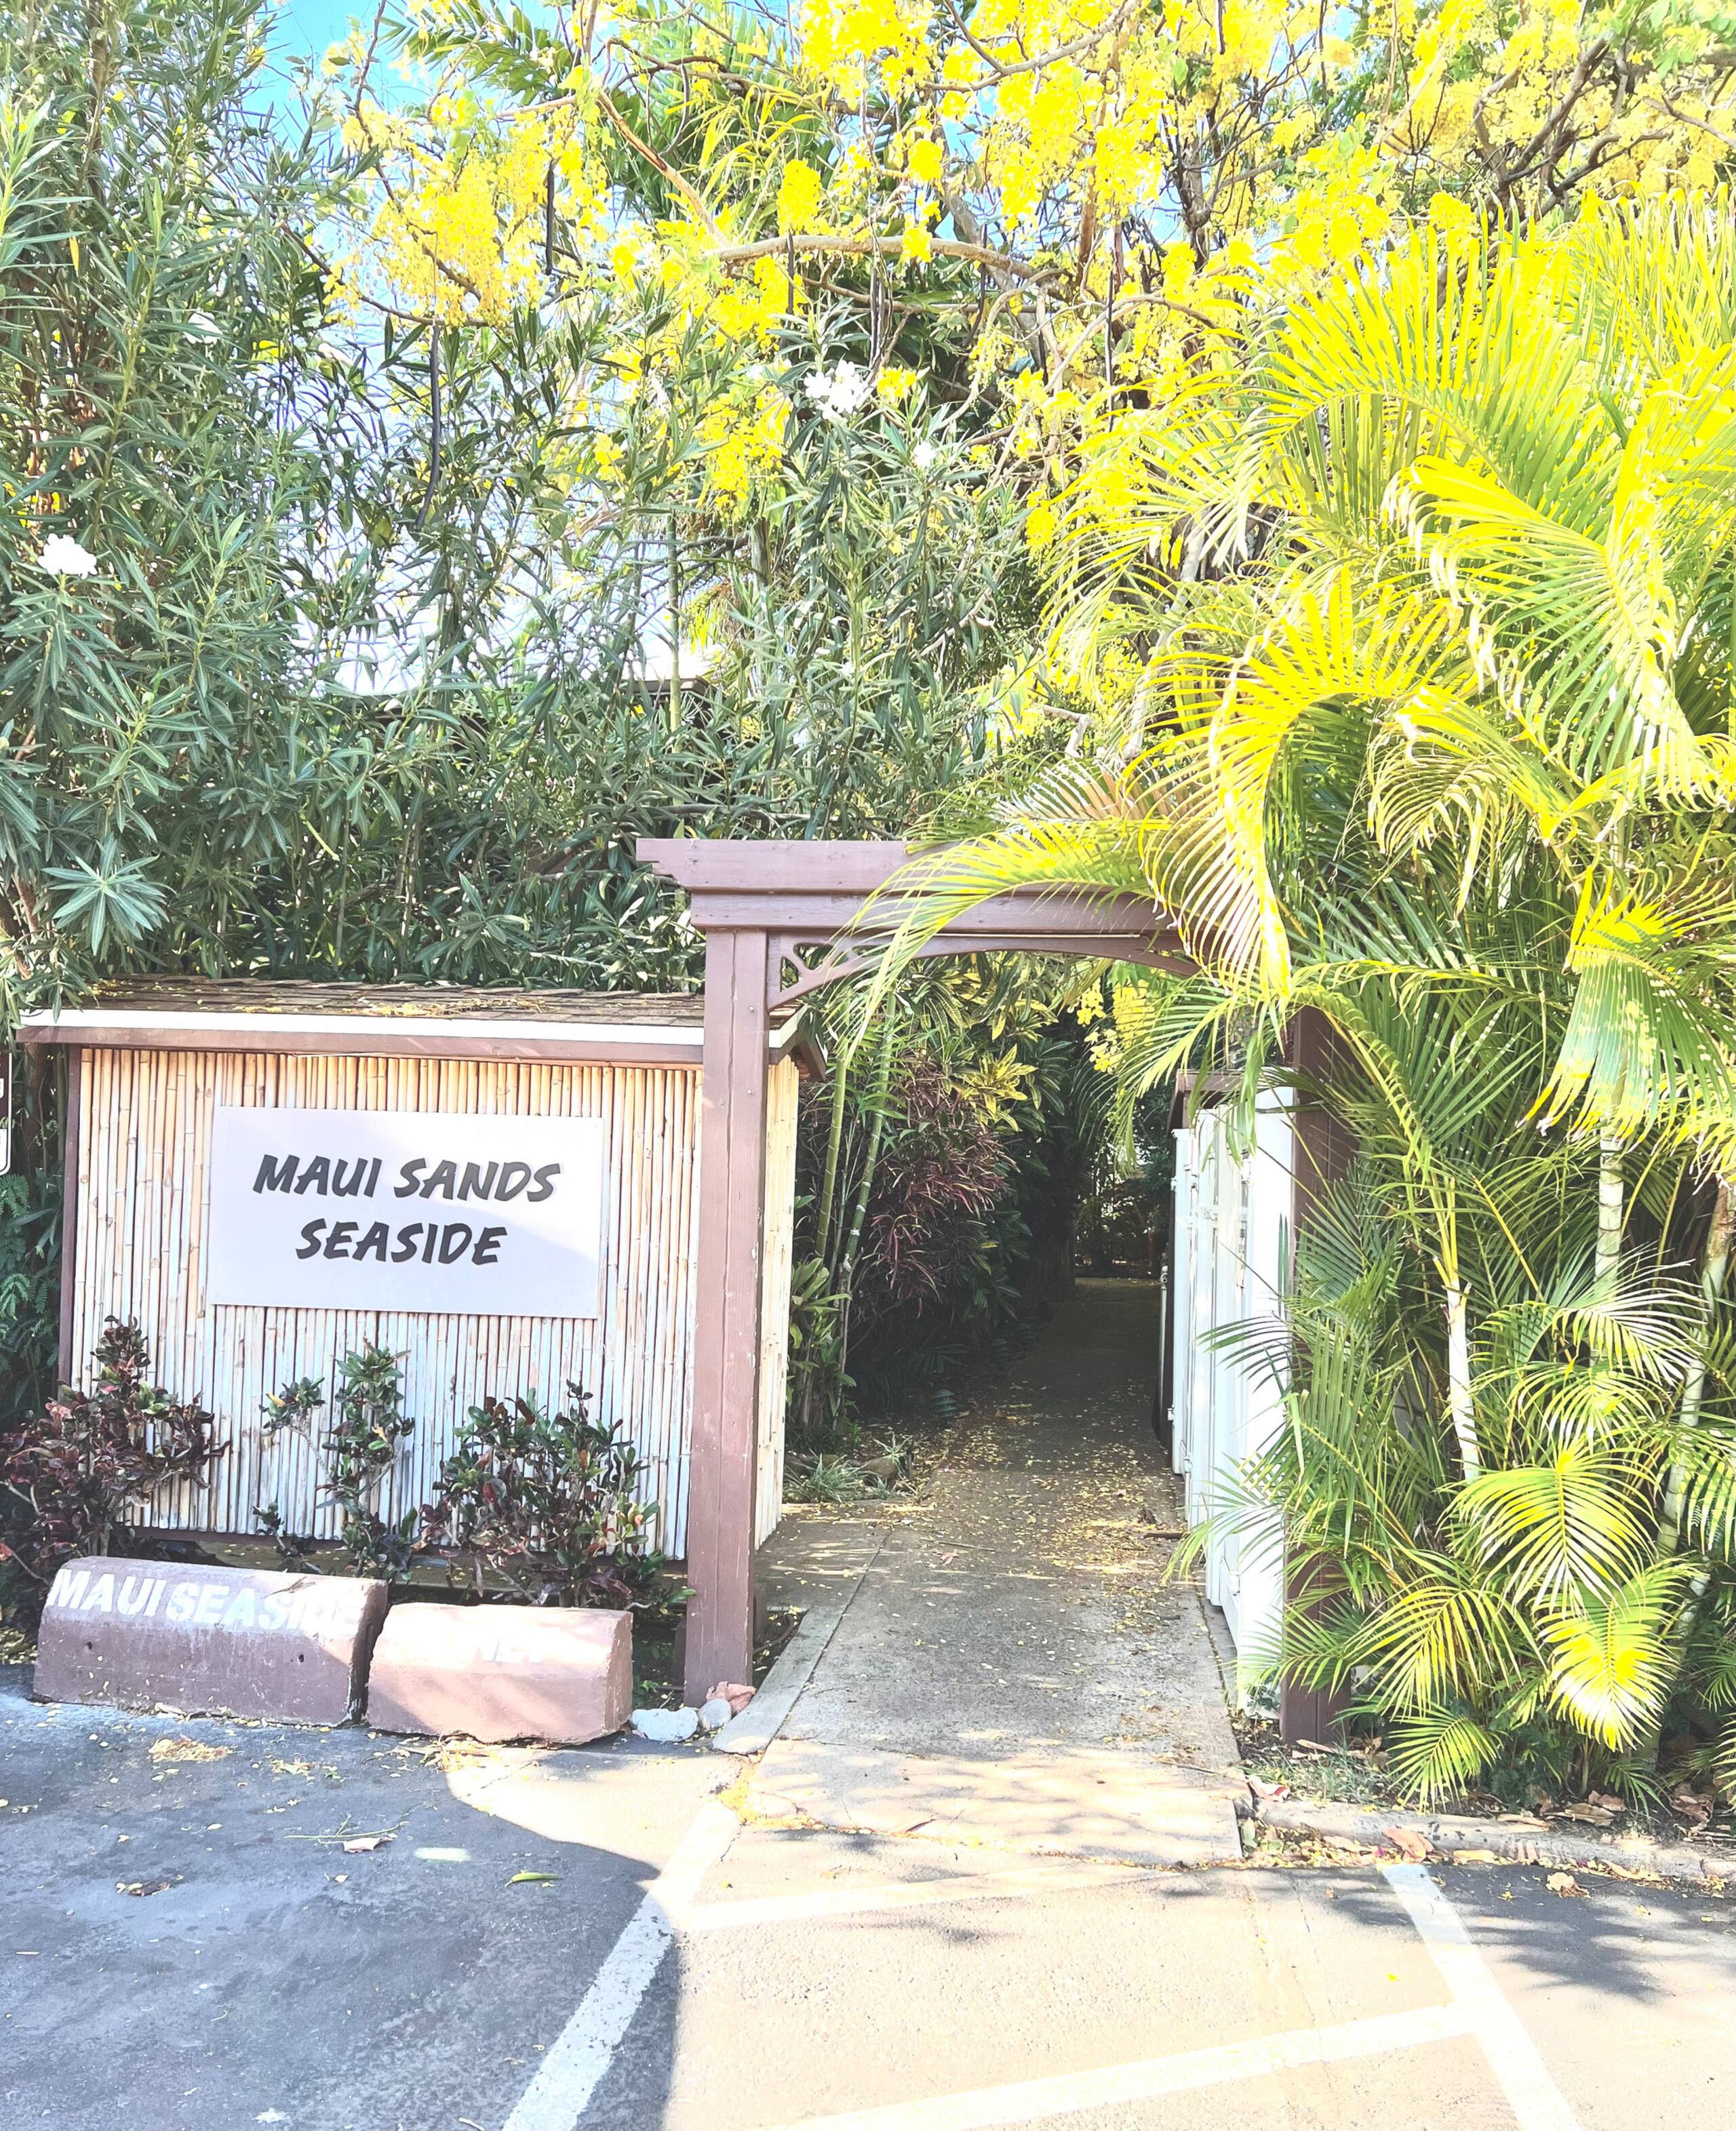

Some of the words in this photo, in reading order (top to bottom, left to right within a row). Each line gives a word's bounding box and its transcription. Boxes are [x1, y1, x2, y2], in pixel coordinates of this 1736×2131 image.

[252, 1154, 382, 1198] MAUI
[393, 1158, 561, 1202] SANDS
[296, 1218, 508, 1266] SEASIDE
[46, 1568, 167, 1618] MAUI
